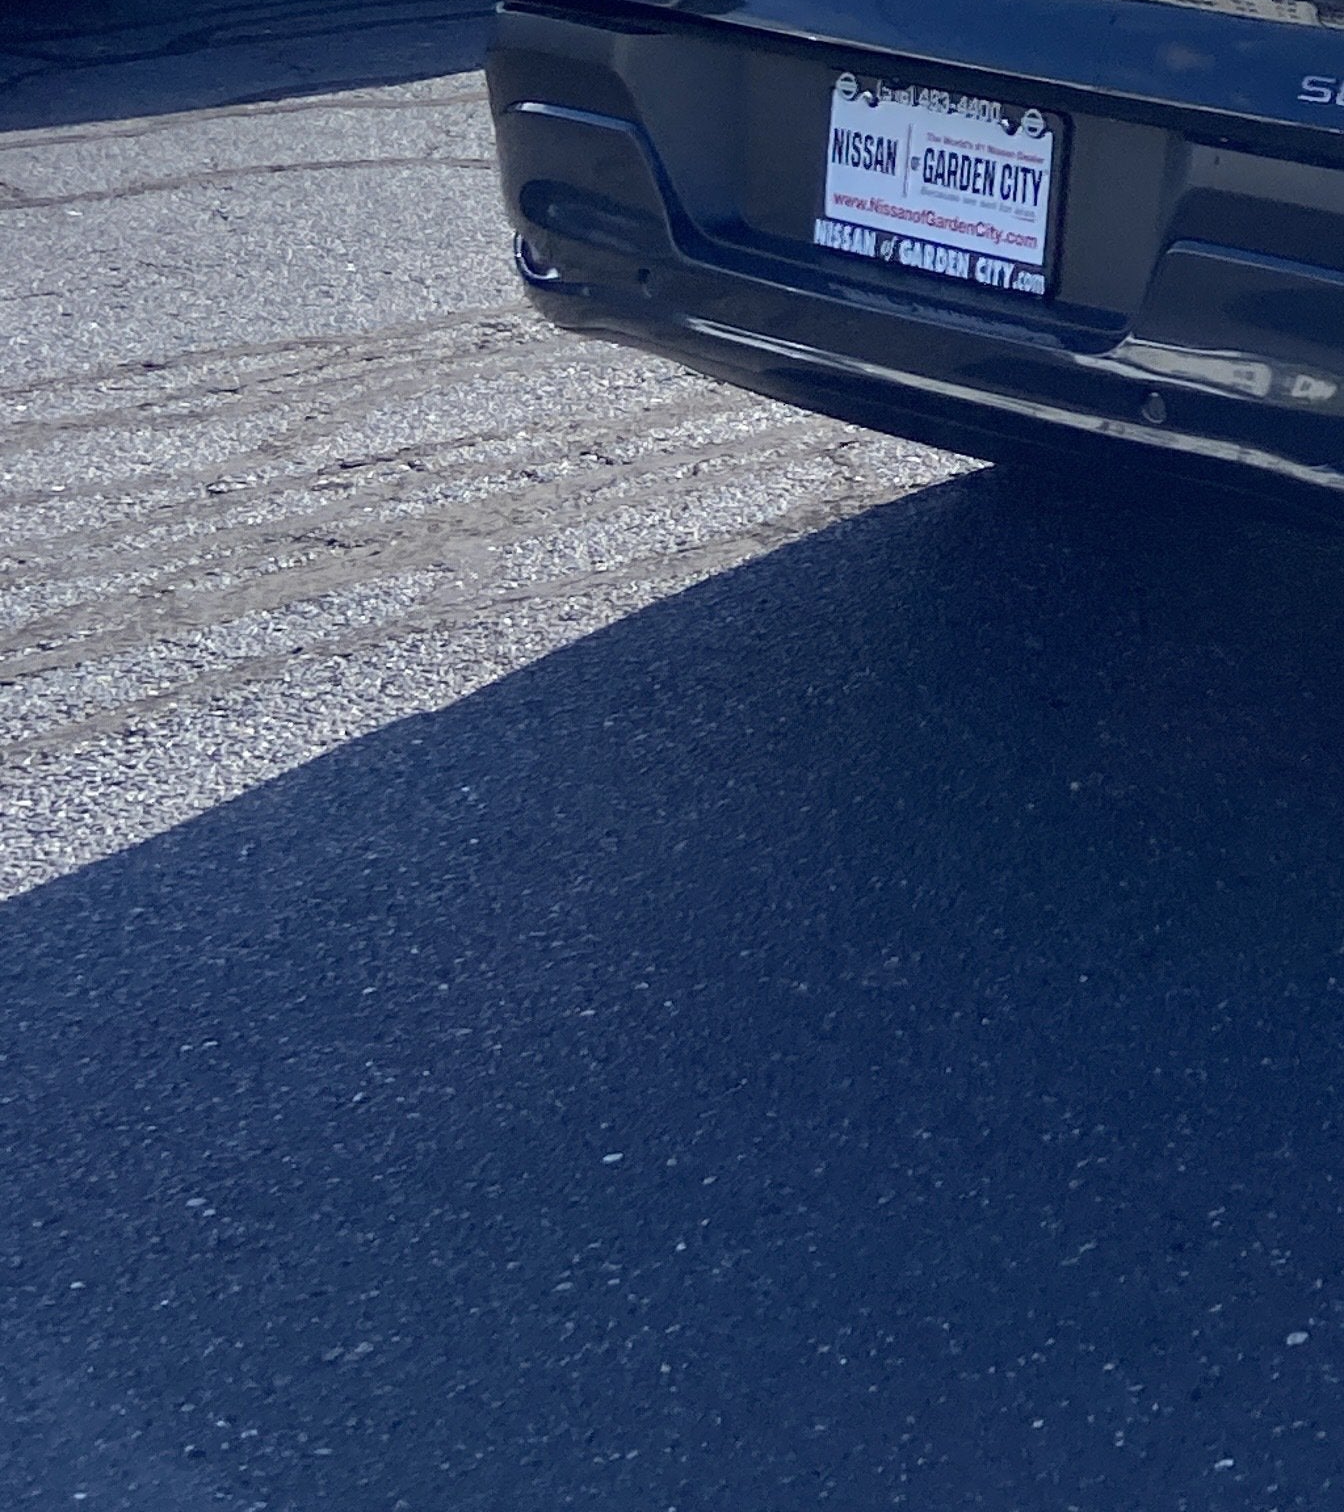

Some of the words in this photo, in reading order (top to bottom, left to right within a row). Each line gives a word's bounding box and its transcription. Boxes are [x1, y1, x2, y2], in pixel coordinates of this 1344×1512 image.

[831, 128, 899, 177] NISSAN
[922, 147, 996, 198] GARDEN
[999, 163, 1043, 207] CITY
[813, 218, 877, 258] NISSAN
[880, 235, 899, 262] of
[898, 239, 971, 280] GARDEN
[833, 193, 1039, 249] www.NissanofGardenCity.com
